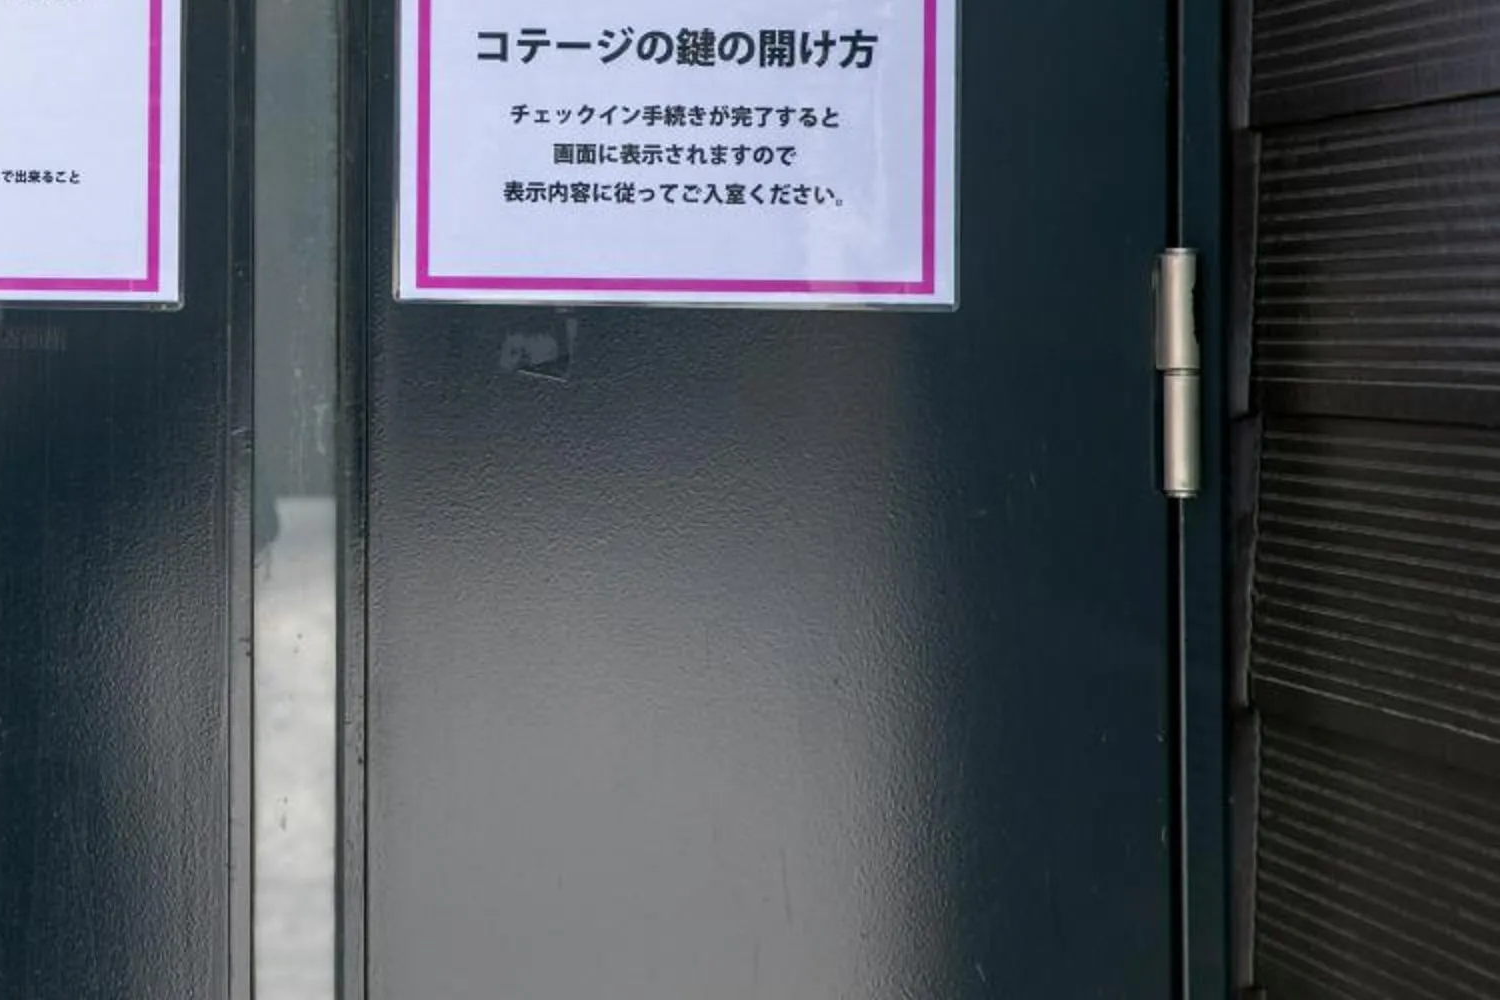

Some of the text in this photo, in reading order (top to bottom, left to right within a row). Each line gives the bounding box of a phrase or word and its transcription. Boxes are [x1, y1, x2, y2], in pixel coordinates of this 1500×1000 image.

[476, 25, 878, 70] コテージの鍵の開け方
[510, 104, 840, 129] チェックイン手続きが完了すると
[553, 142, 796, 166] 画面に表示されますので
[503, 181, 843, 206] 表示内容に従ってご入室ください。
